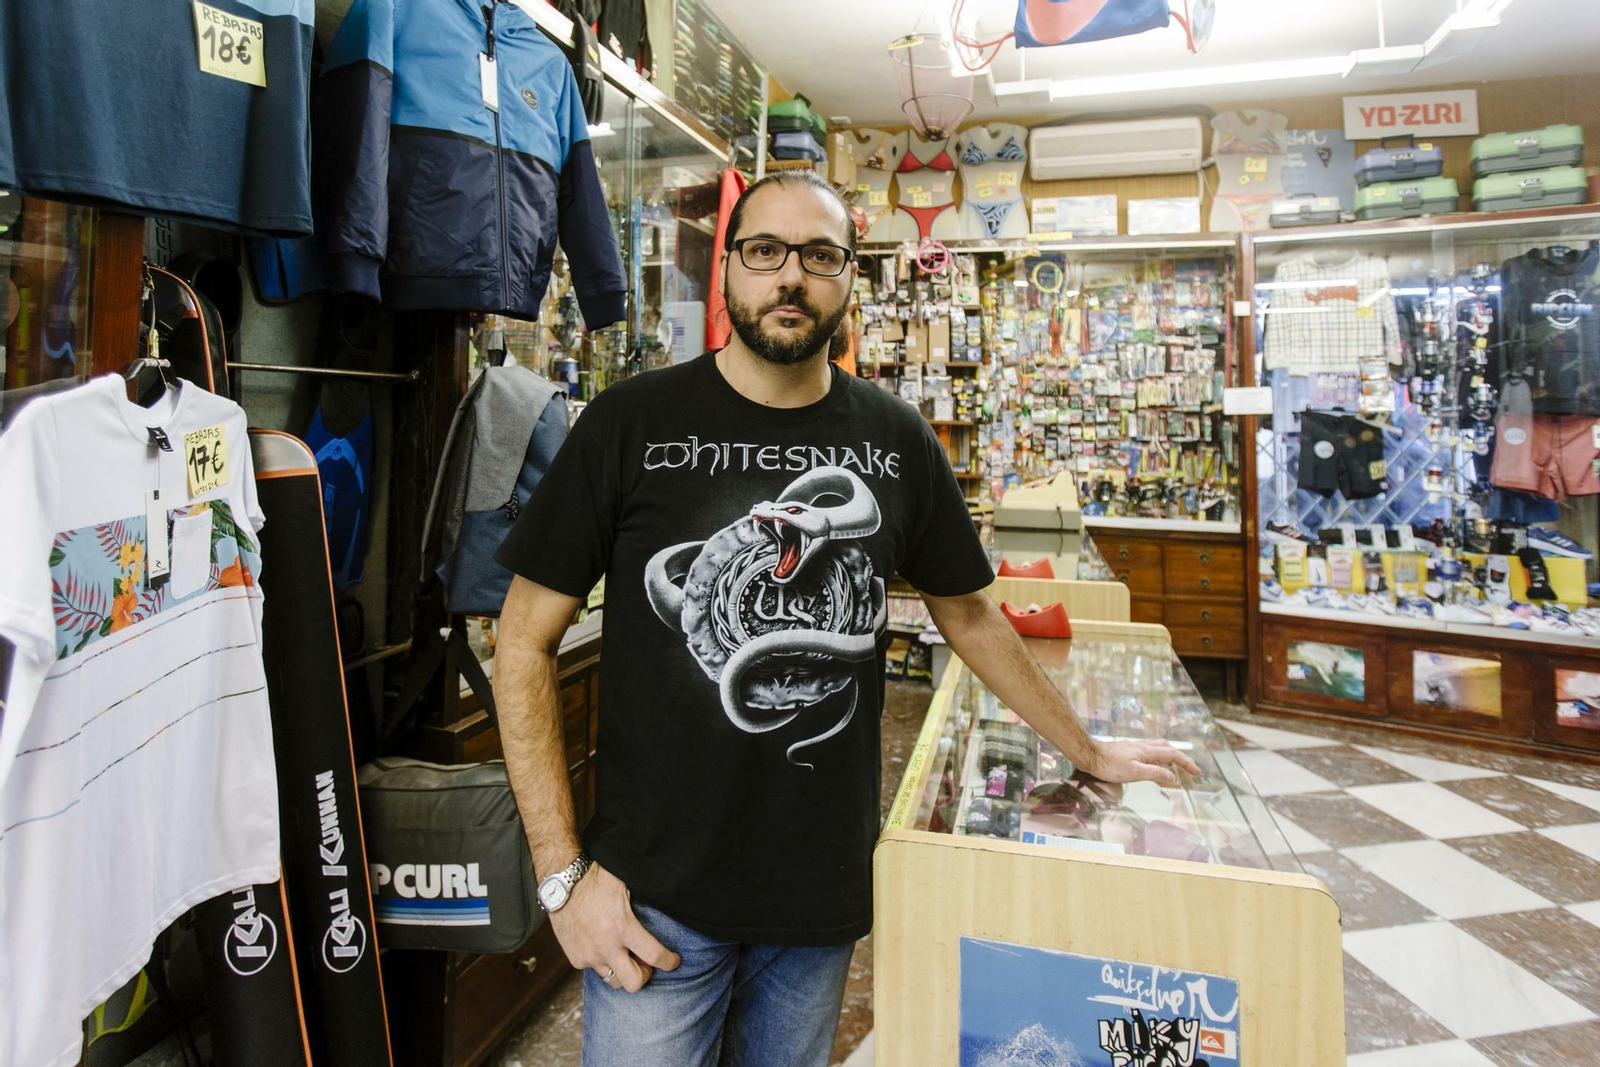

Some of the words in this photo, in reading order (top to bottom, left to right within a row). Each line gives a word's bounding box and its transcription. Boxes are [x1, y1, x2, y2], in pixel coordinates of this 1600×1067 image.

[202, 6, 263, 40] REBAJAS
[202, 25, 252, 66] 18€
[1359, 102, 1462, 127] YO-ZURI
[186, 427, 220, 445] REBAJAS
[189, 440, 224, 483] 17€
[315, 769, 349, 876] KUNNAN
